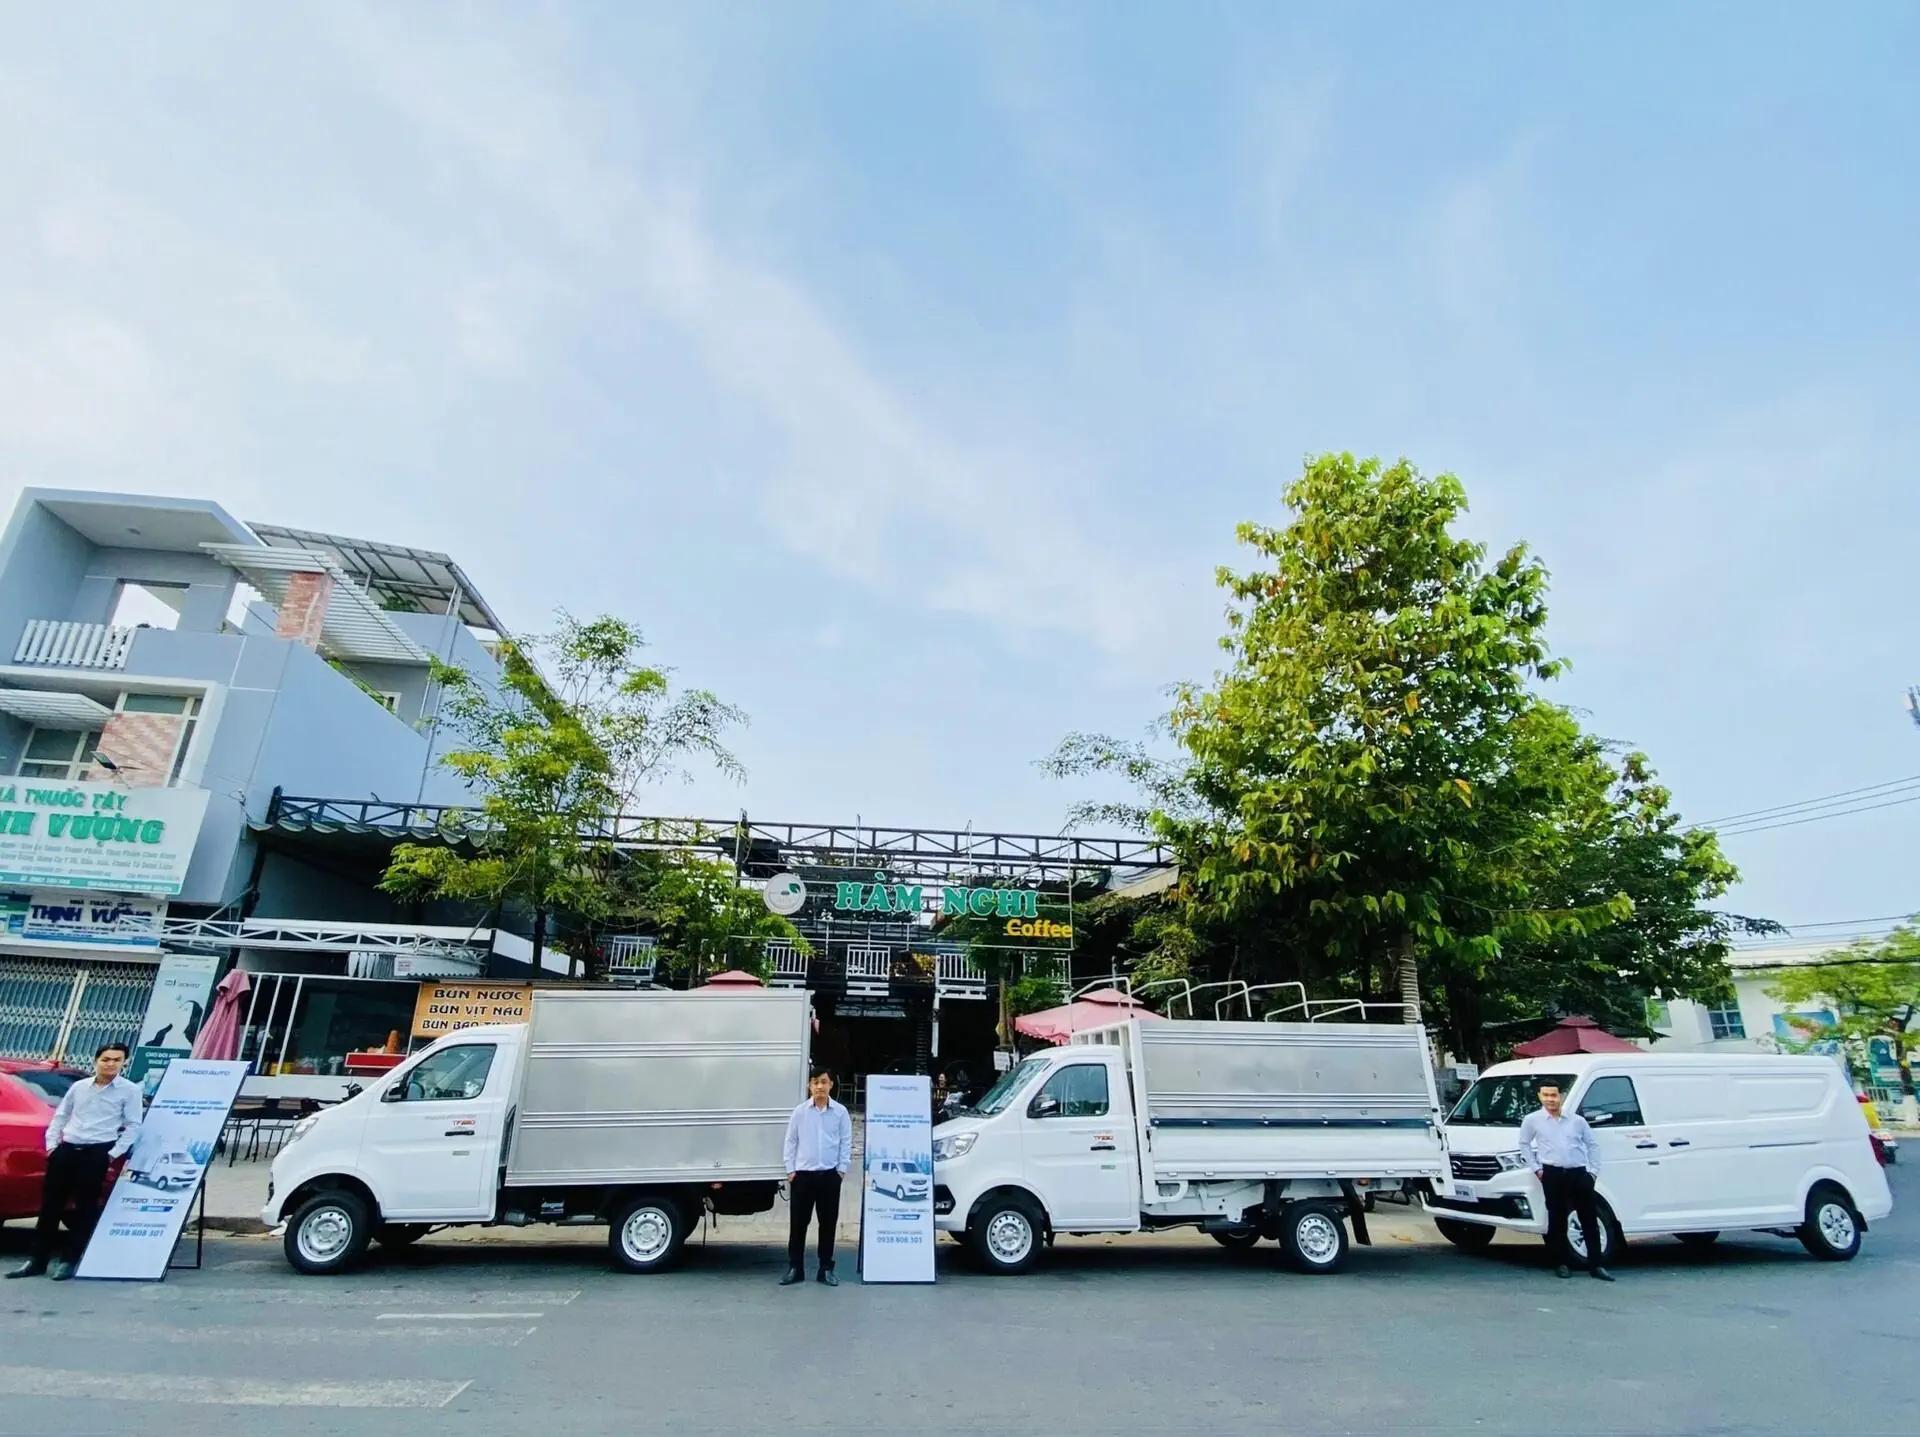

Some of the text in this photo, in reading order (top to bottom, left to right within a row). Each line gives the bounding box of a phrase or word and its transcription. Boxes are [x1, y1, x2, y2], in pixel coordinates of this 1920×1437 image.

[25, 786, 86, 807] THUỐC
[48, 811, 165, 847] VƯỢNG
[834, 872, 1038, 918] HÀM NGHI
[1006, 919, 1072, 937] Coffee
[465, 1005, 488, 1018] VỊT
